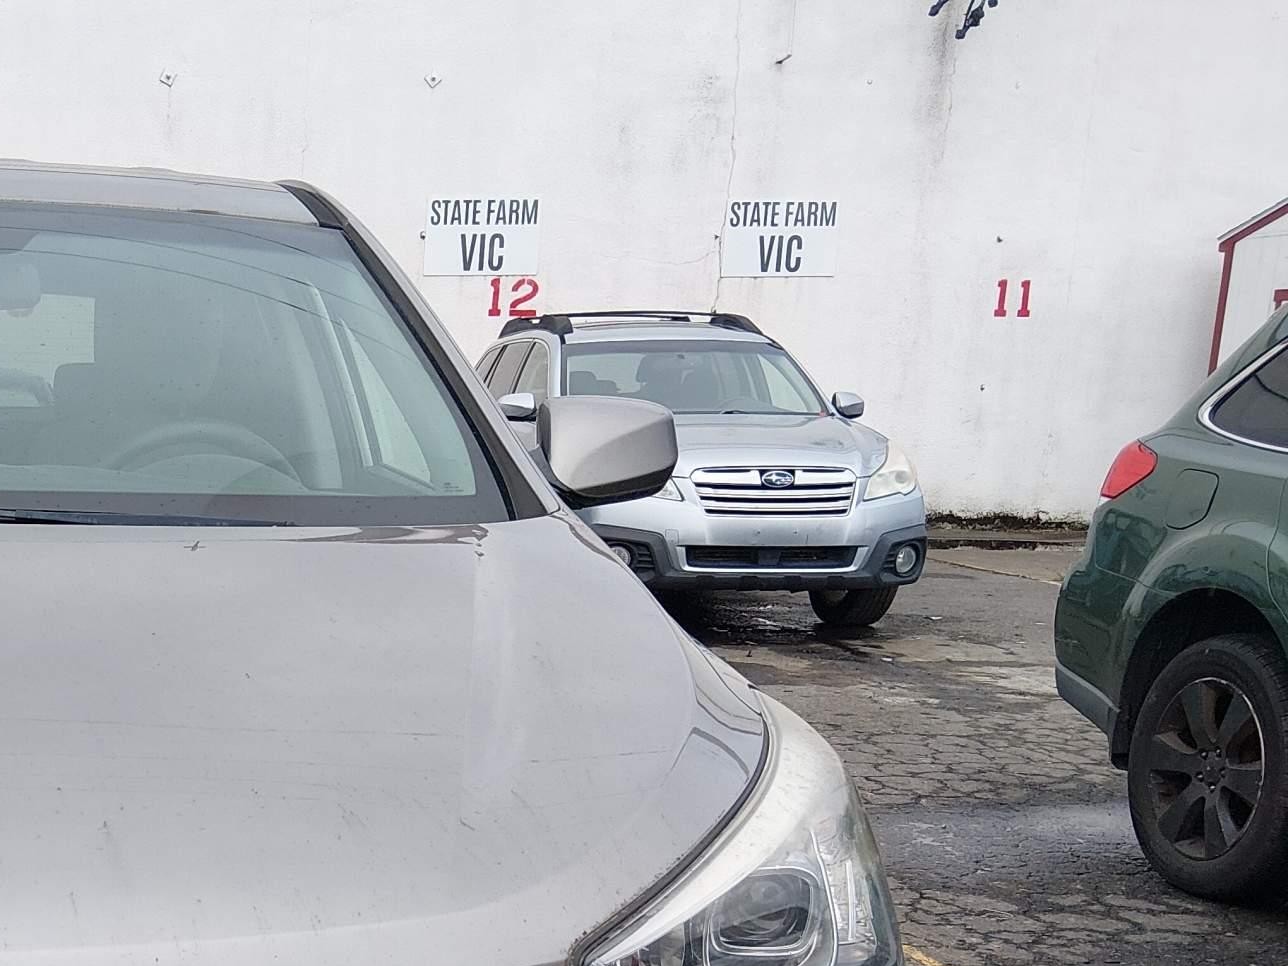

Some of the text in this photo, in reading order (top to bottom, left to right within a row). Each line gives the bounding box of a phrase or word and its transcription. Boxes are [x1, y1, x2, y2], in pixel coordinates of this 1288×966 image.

[430, 199, 539, 226] STATE FARM
[729, 202, 837, 228] STATE FARM
[460, 233, 505, 272] VIC
[759, 234, 803, 273] VIC
[487, 277, 541, 319] 12
[993, 280, 1031, 319] 11
